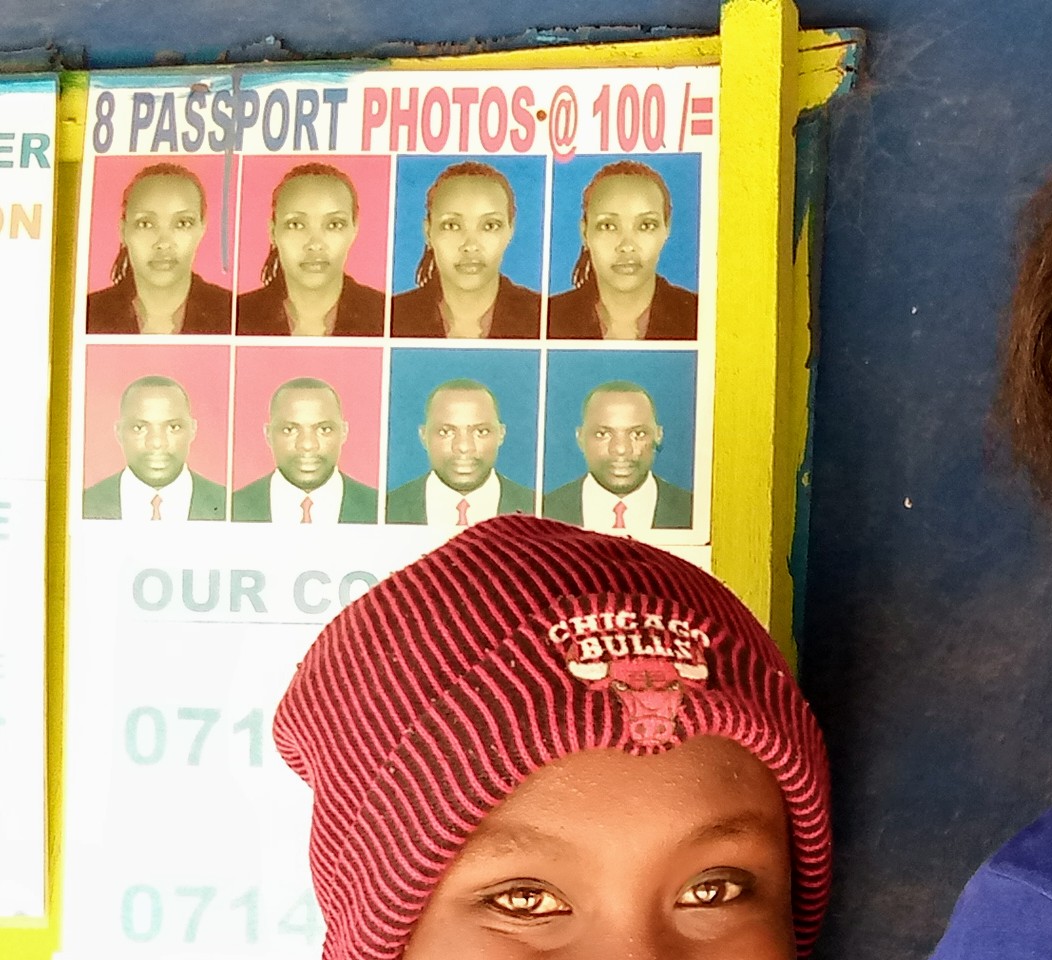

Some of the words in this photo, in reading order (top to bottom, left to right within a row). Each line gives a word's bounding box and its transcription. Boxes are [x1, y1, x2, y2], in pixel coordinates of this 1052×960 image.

[92, 91, 116, 154] 8
[128, 87, 348, 153] PASSPORT
[361, 85, 536, 153] PHOTOS
[549, 85, 579, 164] @
[592, 83, 666, 153] 100
[132, 568, 269, 615] OUR
[579, 633, 692, 661] BULLS
[123, 705, 266, 769] 071
[120, 884, 323, 944] 0714
